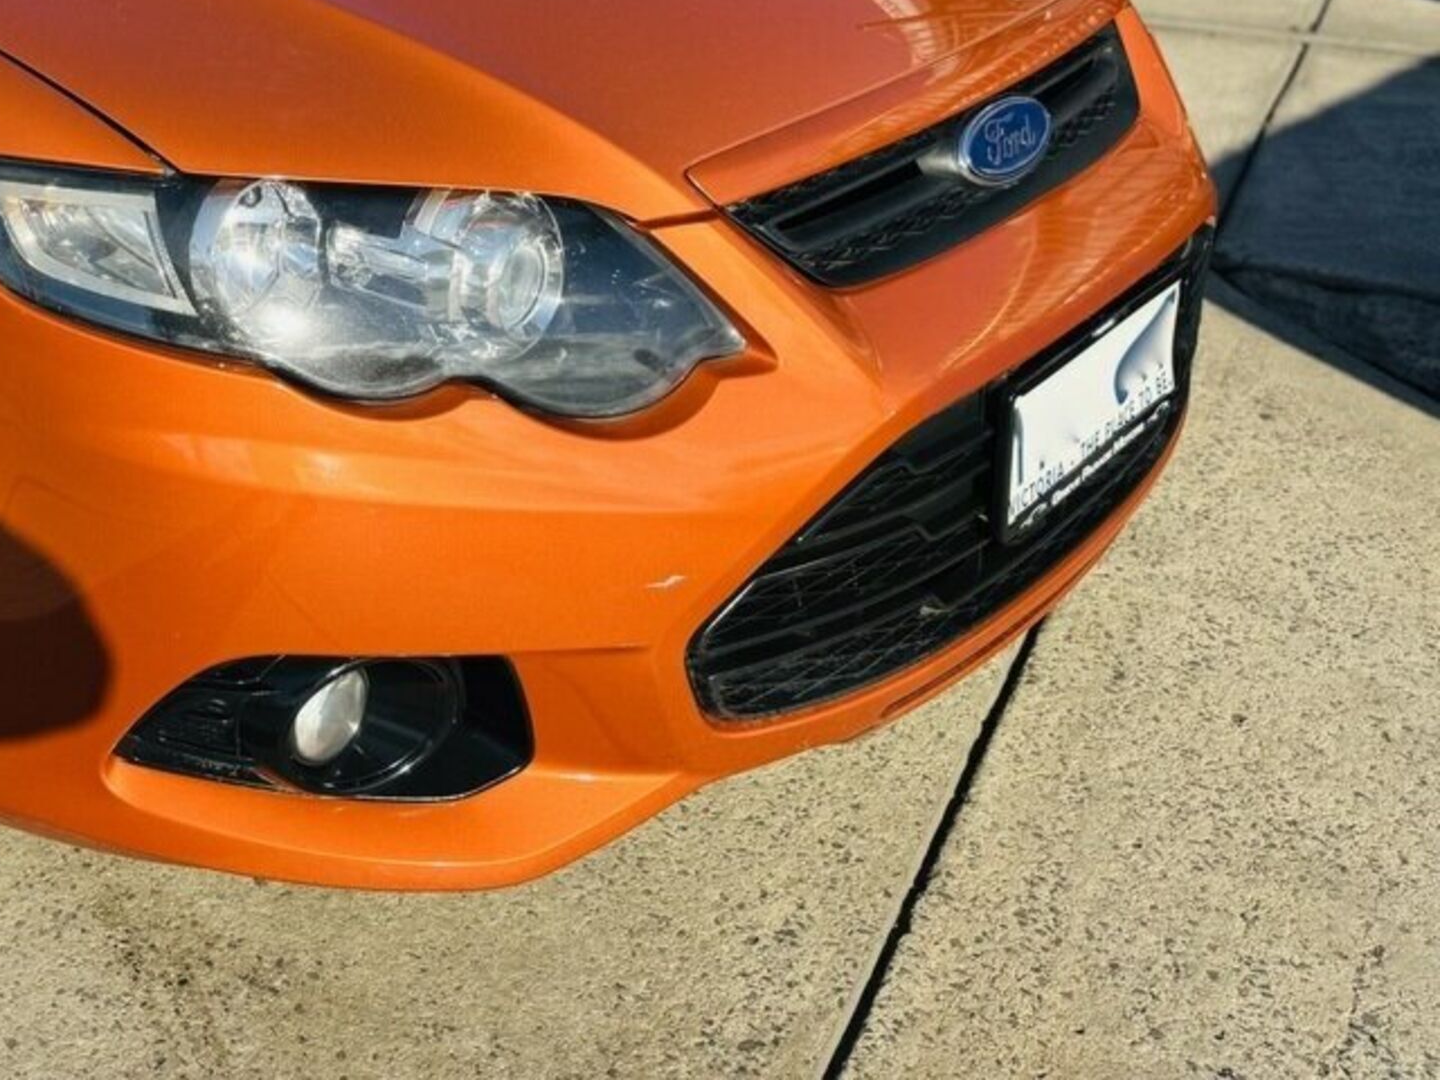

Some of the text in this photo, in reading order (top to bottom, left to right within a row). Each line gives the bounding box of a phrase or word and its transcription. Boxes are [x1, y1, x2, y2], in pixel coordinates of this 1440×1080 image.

[985, 111, 1037, 166] Ford
[1009, 461, 1064, 517] VICTORIA
[1080, 429, 1101, 460] THE
